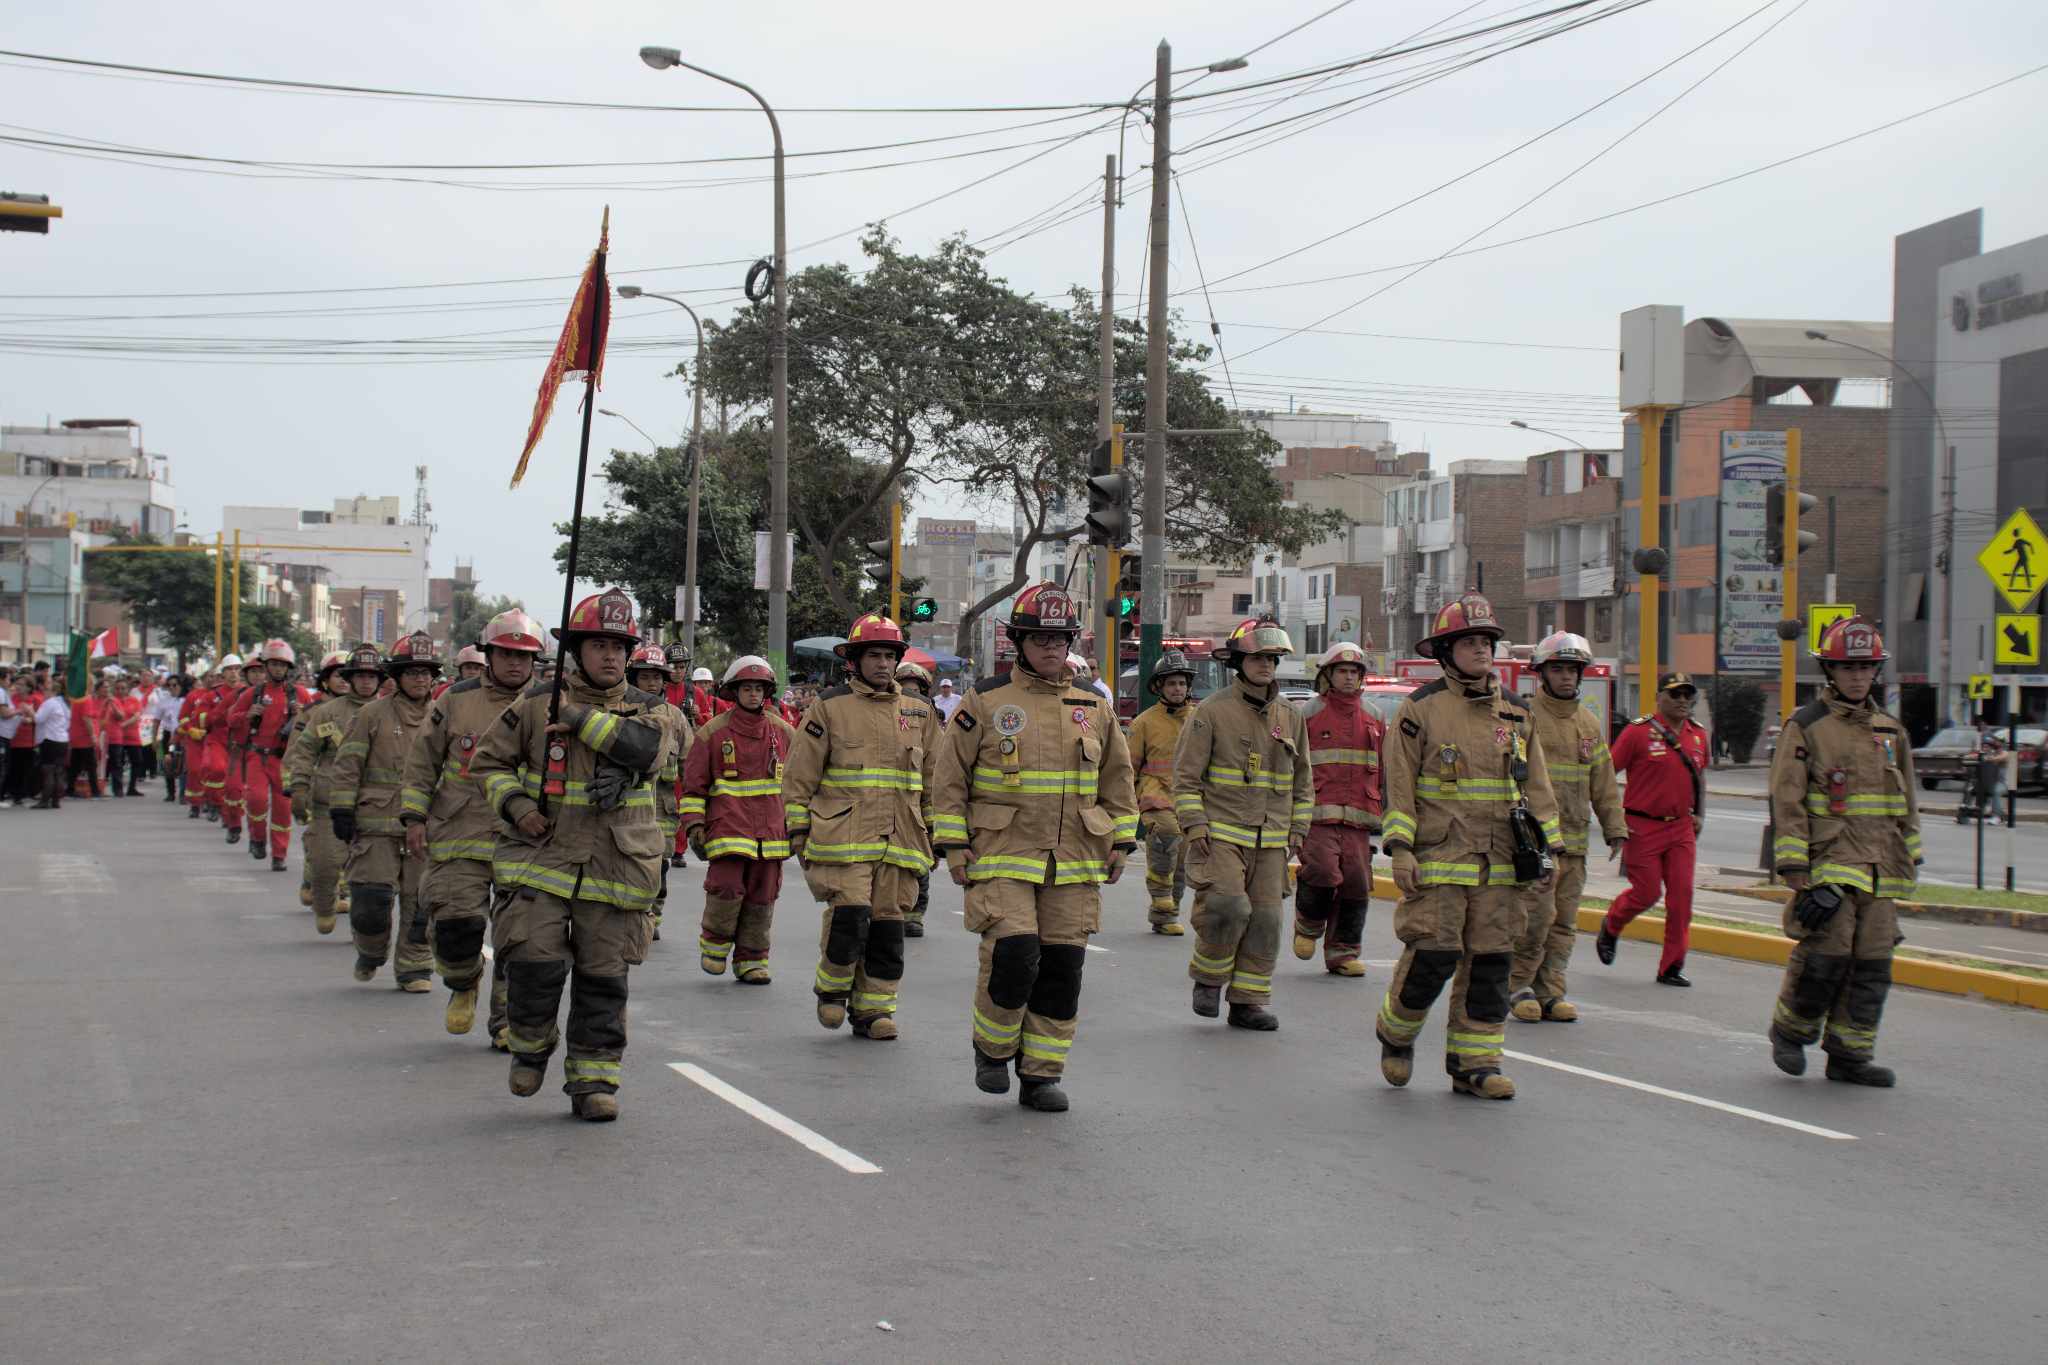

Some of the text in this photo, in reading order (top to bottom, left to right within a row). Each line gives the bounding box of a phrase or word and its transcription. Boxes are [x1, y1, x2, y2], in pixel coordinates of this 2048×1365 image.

[1730, 471, 1787, 480] Y LAPAROSCOPIC
[1736, 501, 1767, 510] GINECOL
[926, 524, 974, 534] HOTEL
[1038, 590, 1068, 600] LOS OLIVOS
[1728, 593, 1752, 602] PARTOS
[1752, 594, 1757, 602] Y
[601, 595, 631, 607] LOS OLIVOS
[603, 604, 631, 624] 161
[1040, 601, 1067, 618] 161
[1466, 604, 1490, 619] 161
[1263, 631, 1277, 642] 161
[1846, 634, 1873, 649] 161
[411, 642, 433, 655] 161
[997, 641, 1008, 649] 24
[1733, 644, 1780, 653] ODONTOLOGIA
[648, 651, 663, 661] 161
[671, 648, 684, 657] 161
[360, 653, 374, 663] 161
